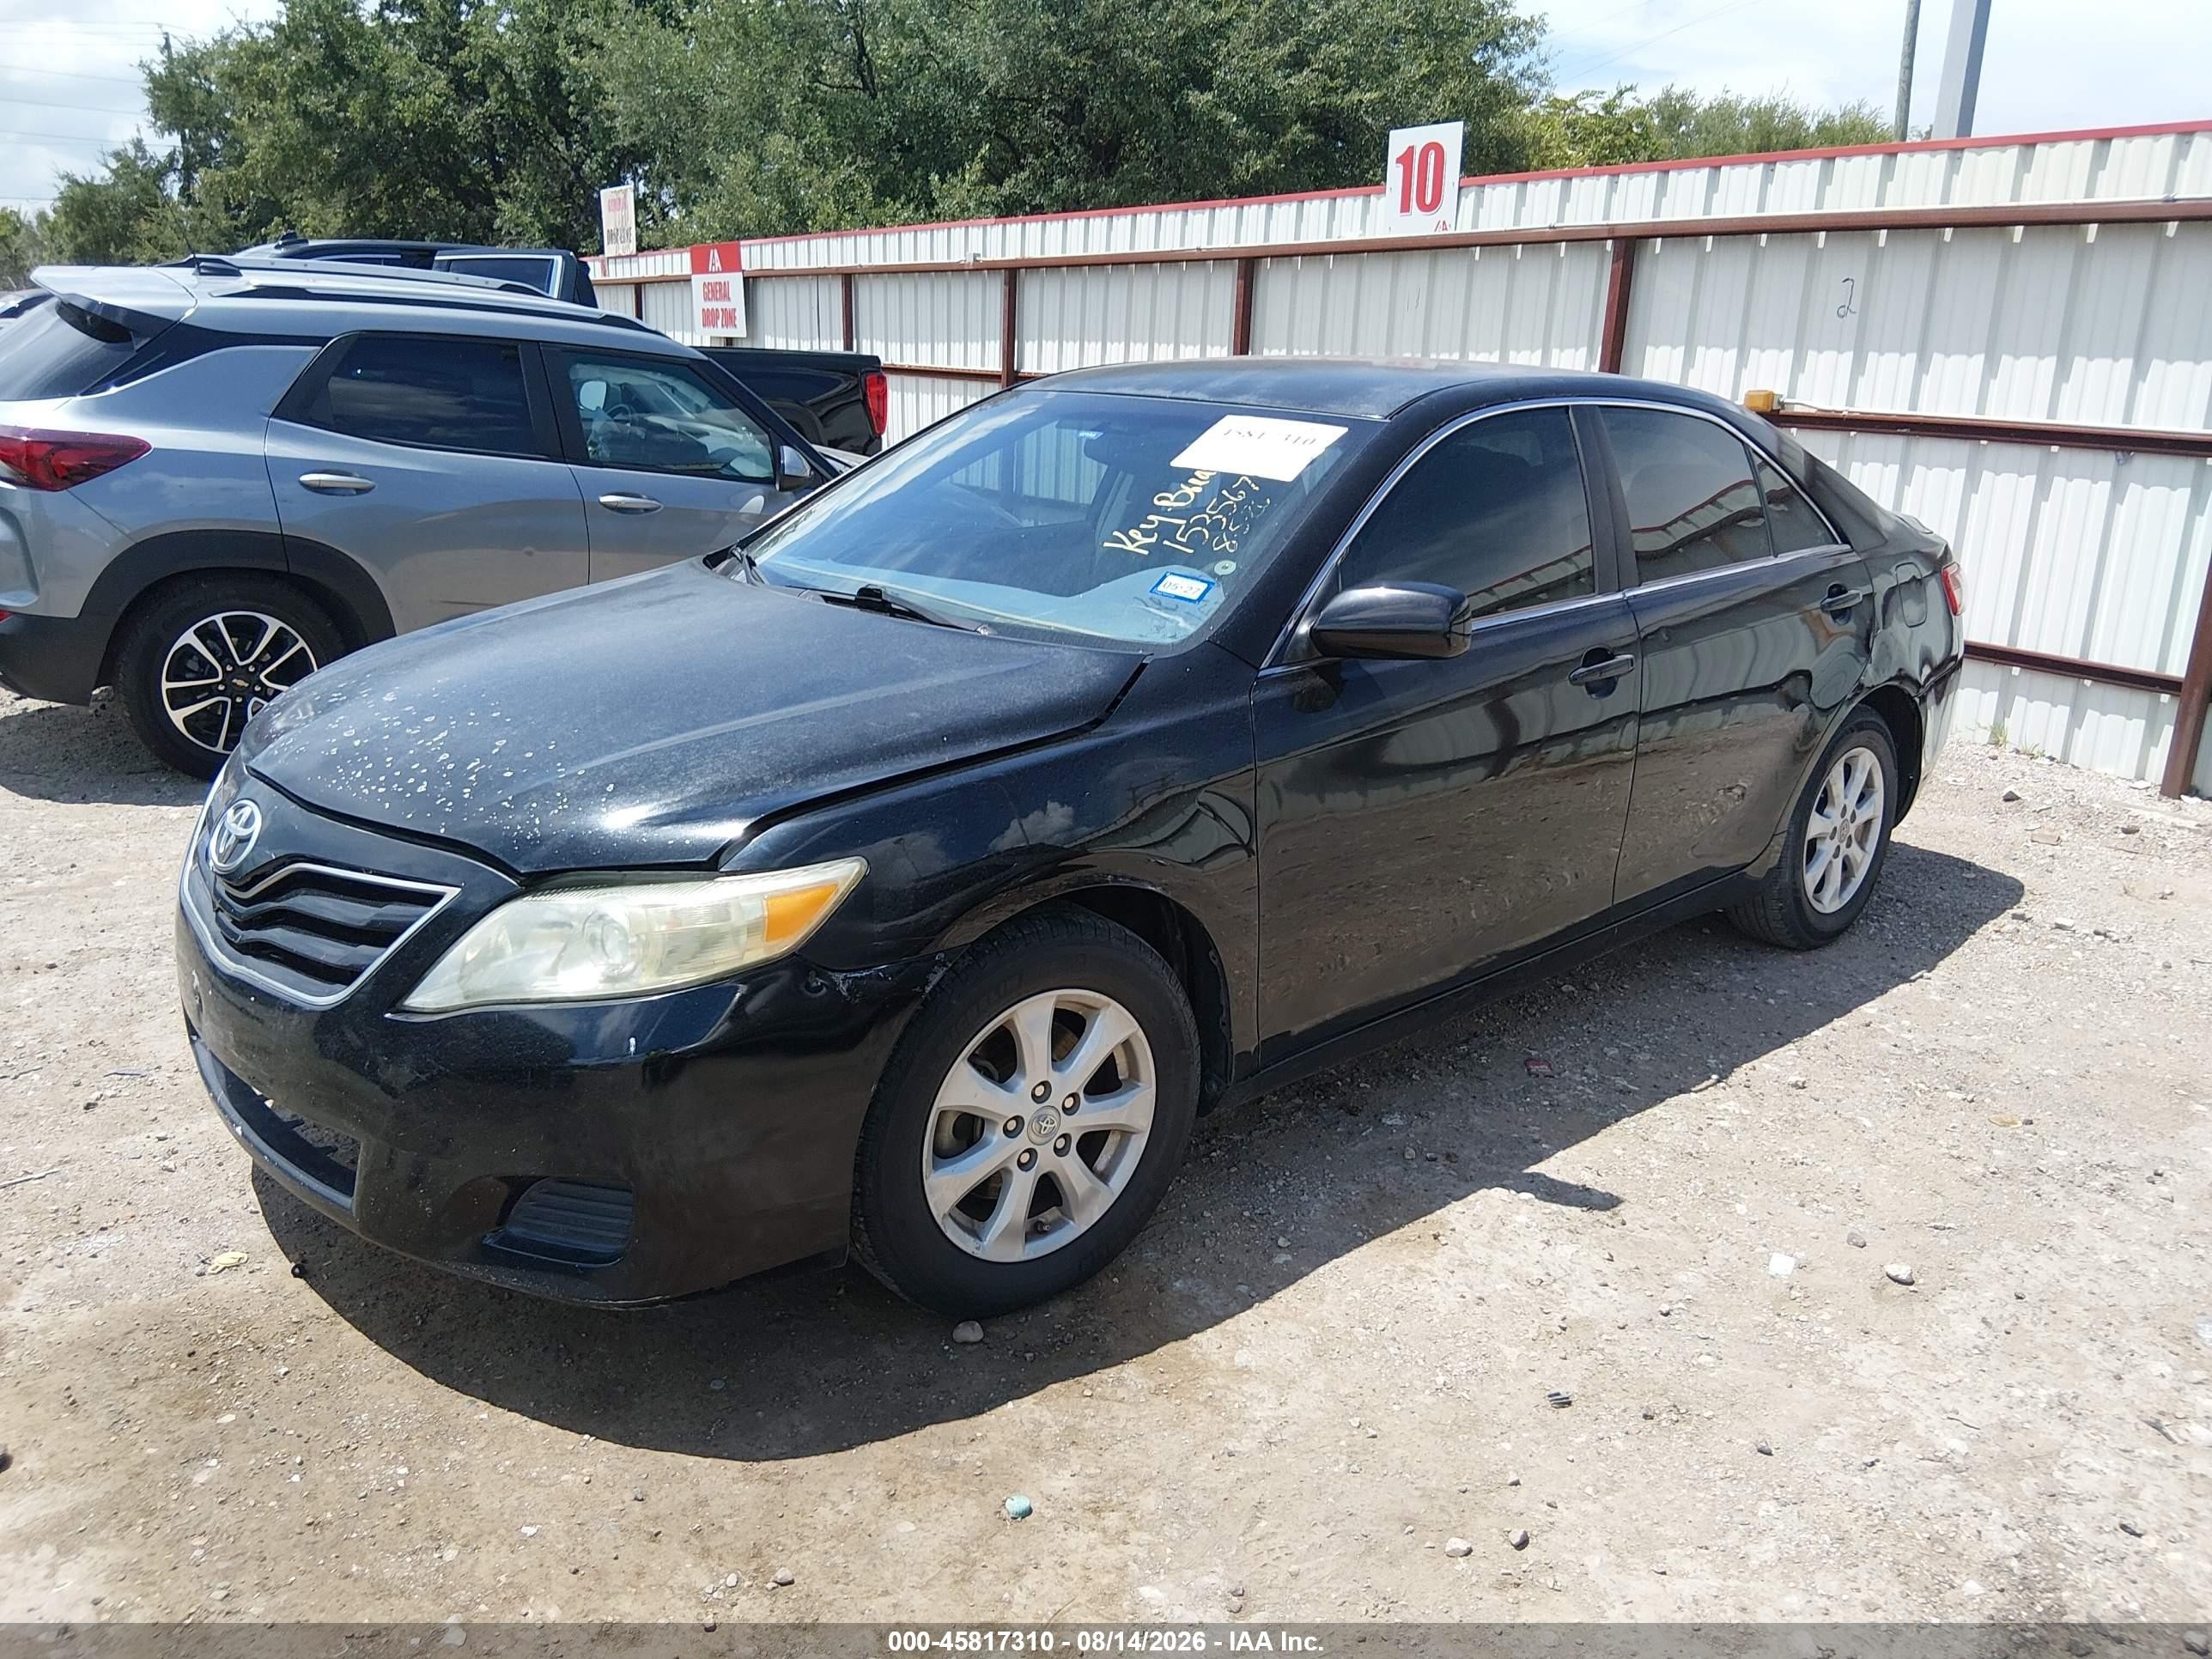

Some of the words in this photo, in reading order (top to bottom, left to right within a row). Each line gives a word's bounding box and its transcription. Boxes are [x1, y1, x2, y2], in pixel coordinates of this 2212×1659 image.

[1395, 141, 1446, 215] 10
[702, 281, 731, 302] GENERAL
[1837, 277, 1856, 319] 2
[702, 307, 720, 329] DROP
[721, 307, 737, 329] ZONE
